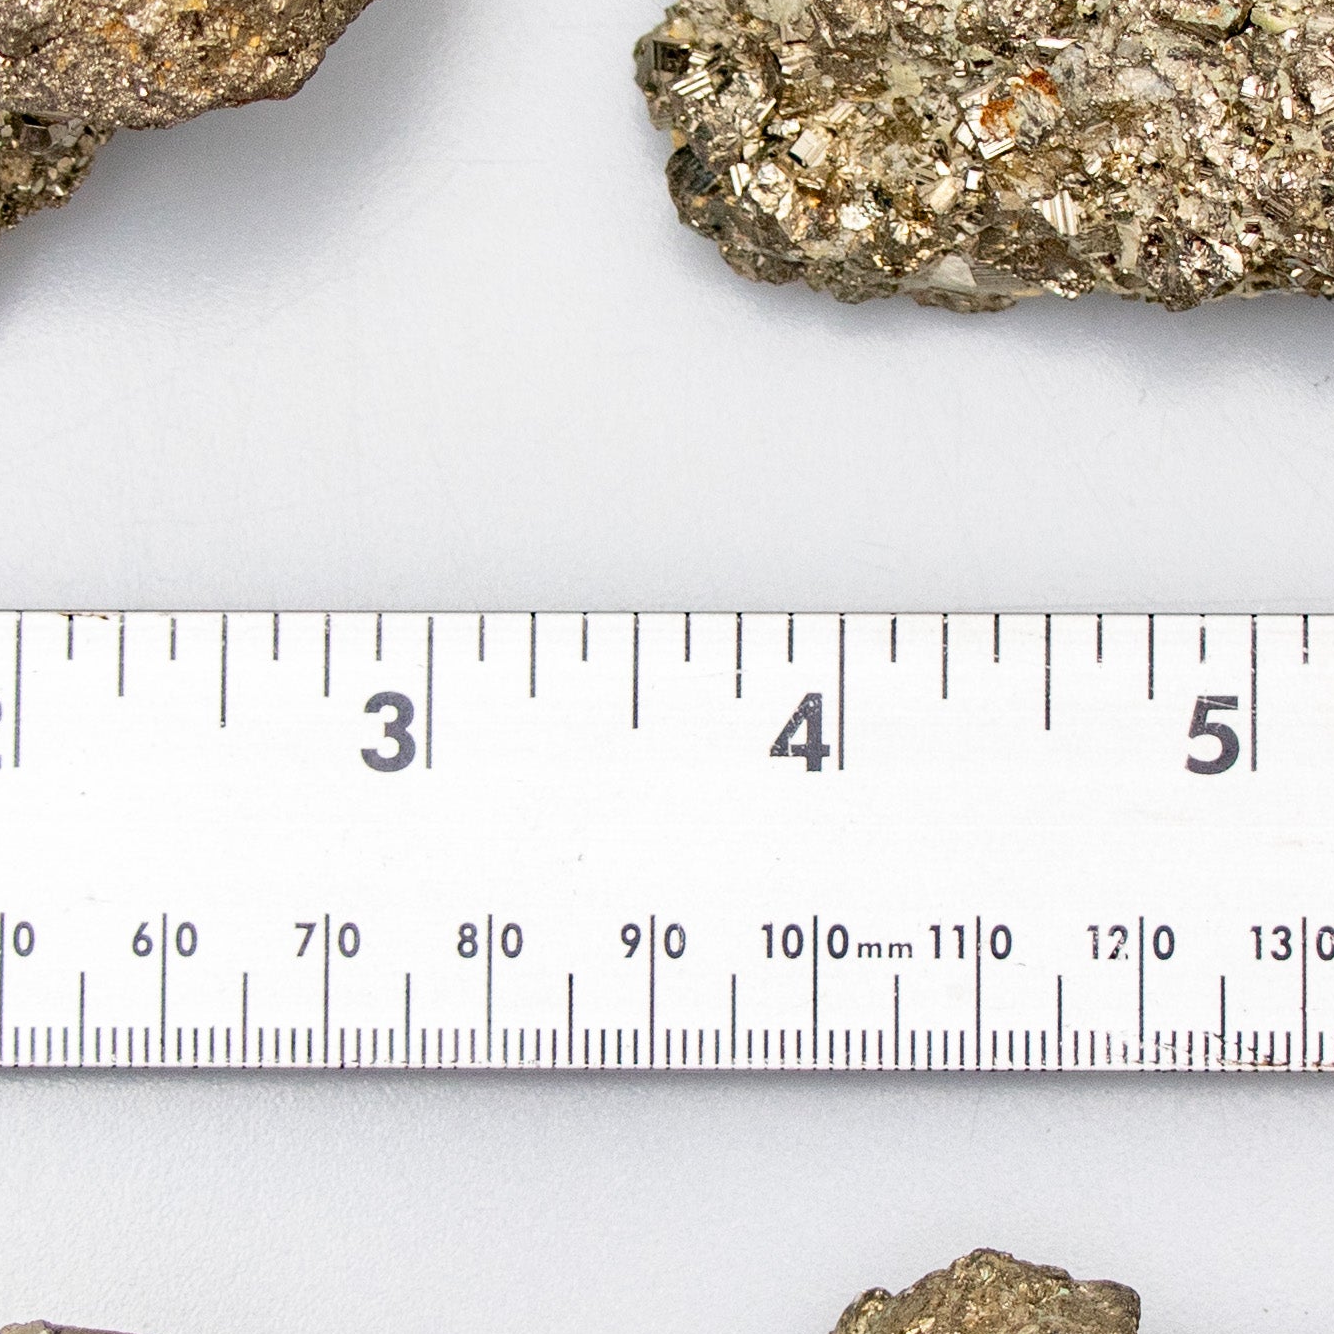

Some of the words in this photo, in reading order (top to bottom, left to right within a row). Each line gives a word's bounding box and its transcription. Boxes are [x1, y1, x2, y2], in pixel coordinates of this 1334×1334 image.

[360, 690, 417, 773] 3
[769, 692, 830, 773] 4
[1184, 694, 1240, 775] 5
[131, 922, 198, 957] 60
[294, 922, 361, 958] 70
[456, 923, 524, 959] 80
[620, 923, 687, 959] 90
[928, 924, 1013, 960] 110
[1086, 925, 1175, 961] 120
